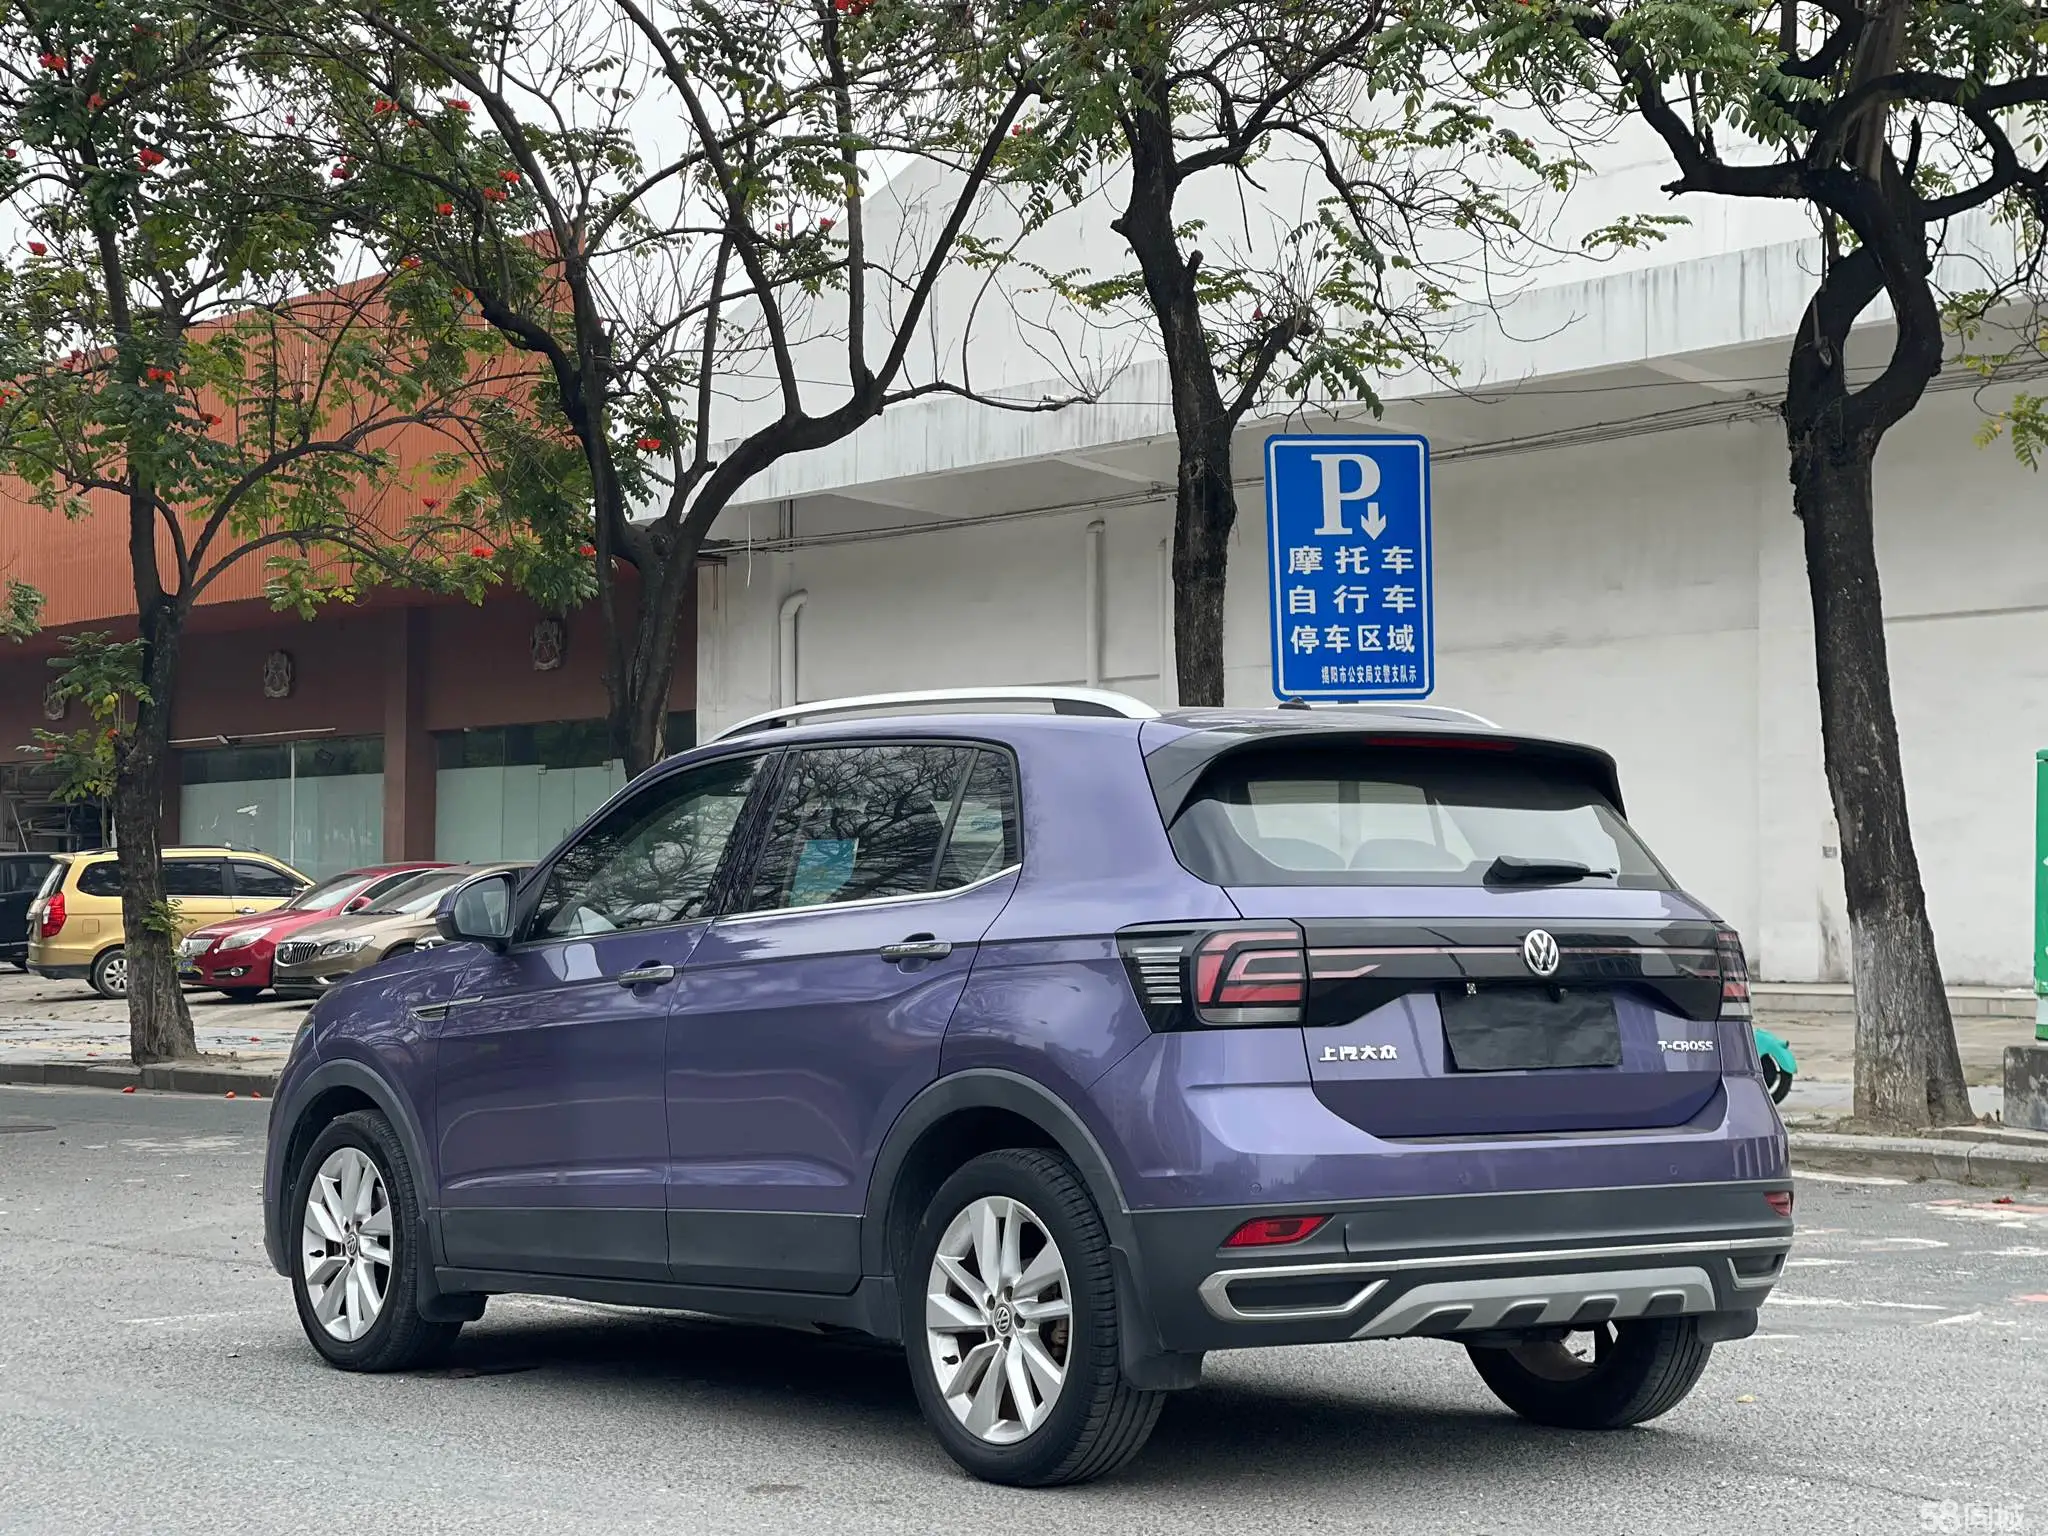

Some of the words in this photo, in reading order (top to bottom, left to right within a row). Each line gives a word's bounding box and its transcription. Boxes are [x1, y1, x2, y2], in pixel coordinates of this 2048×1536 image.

[1310, 453, 1381, 536] P
[1287, 545, 1415, 575] 摩托车
[1288, 585, 1417, 615] 自行车
[1290, 624, 1416, 655] 停车区域
[1319, 1044, 1398, 1062] 上汽大众
[1657, 1040, 1714, 1052] T-CROSS
